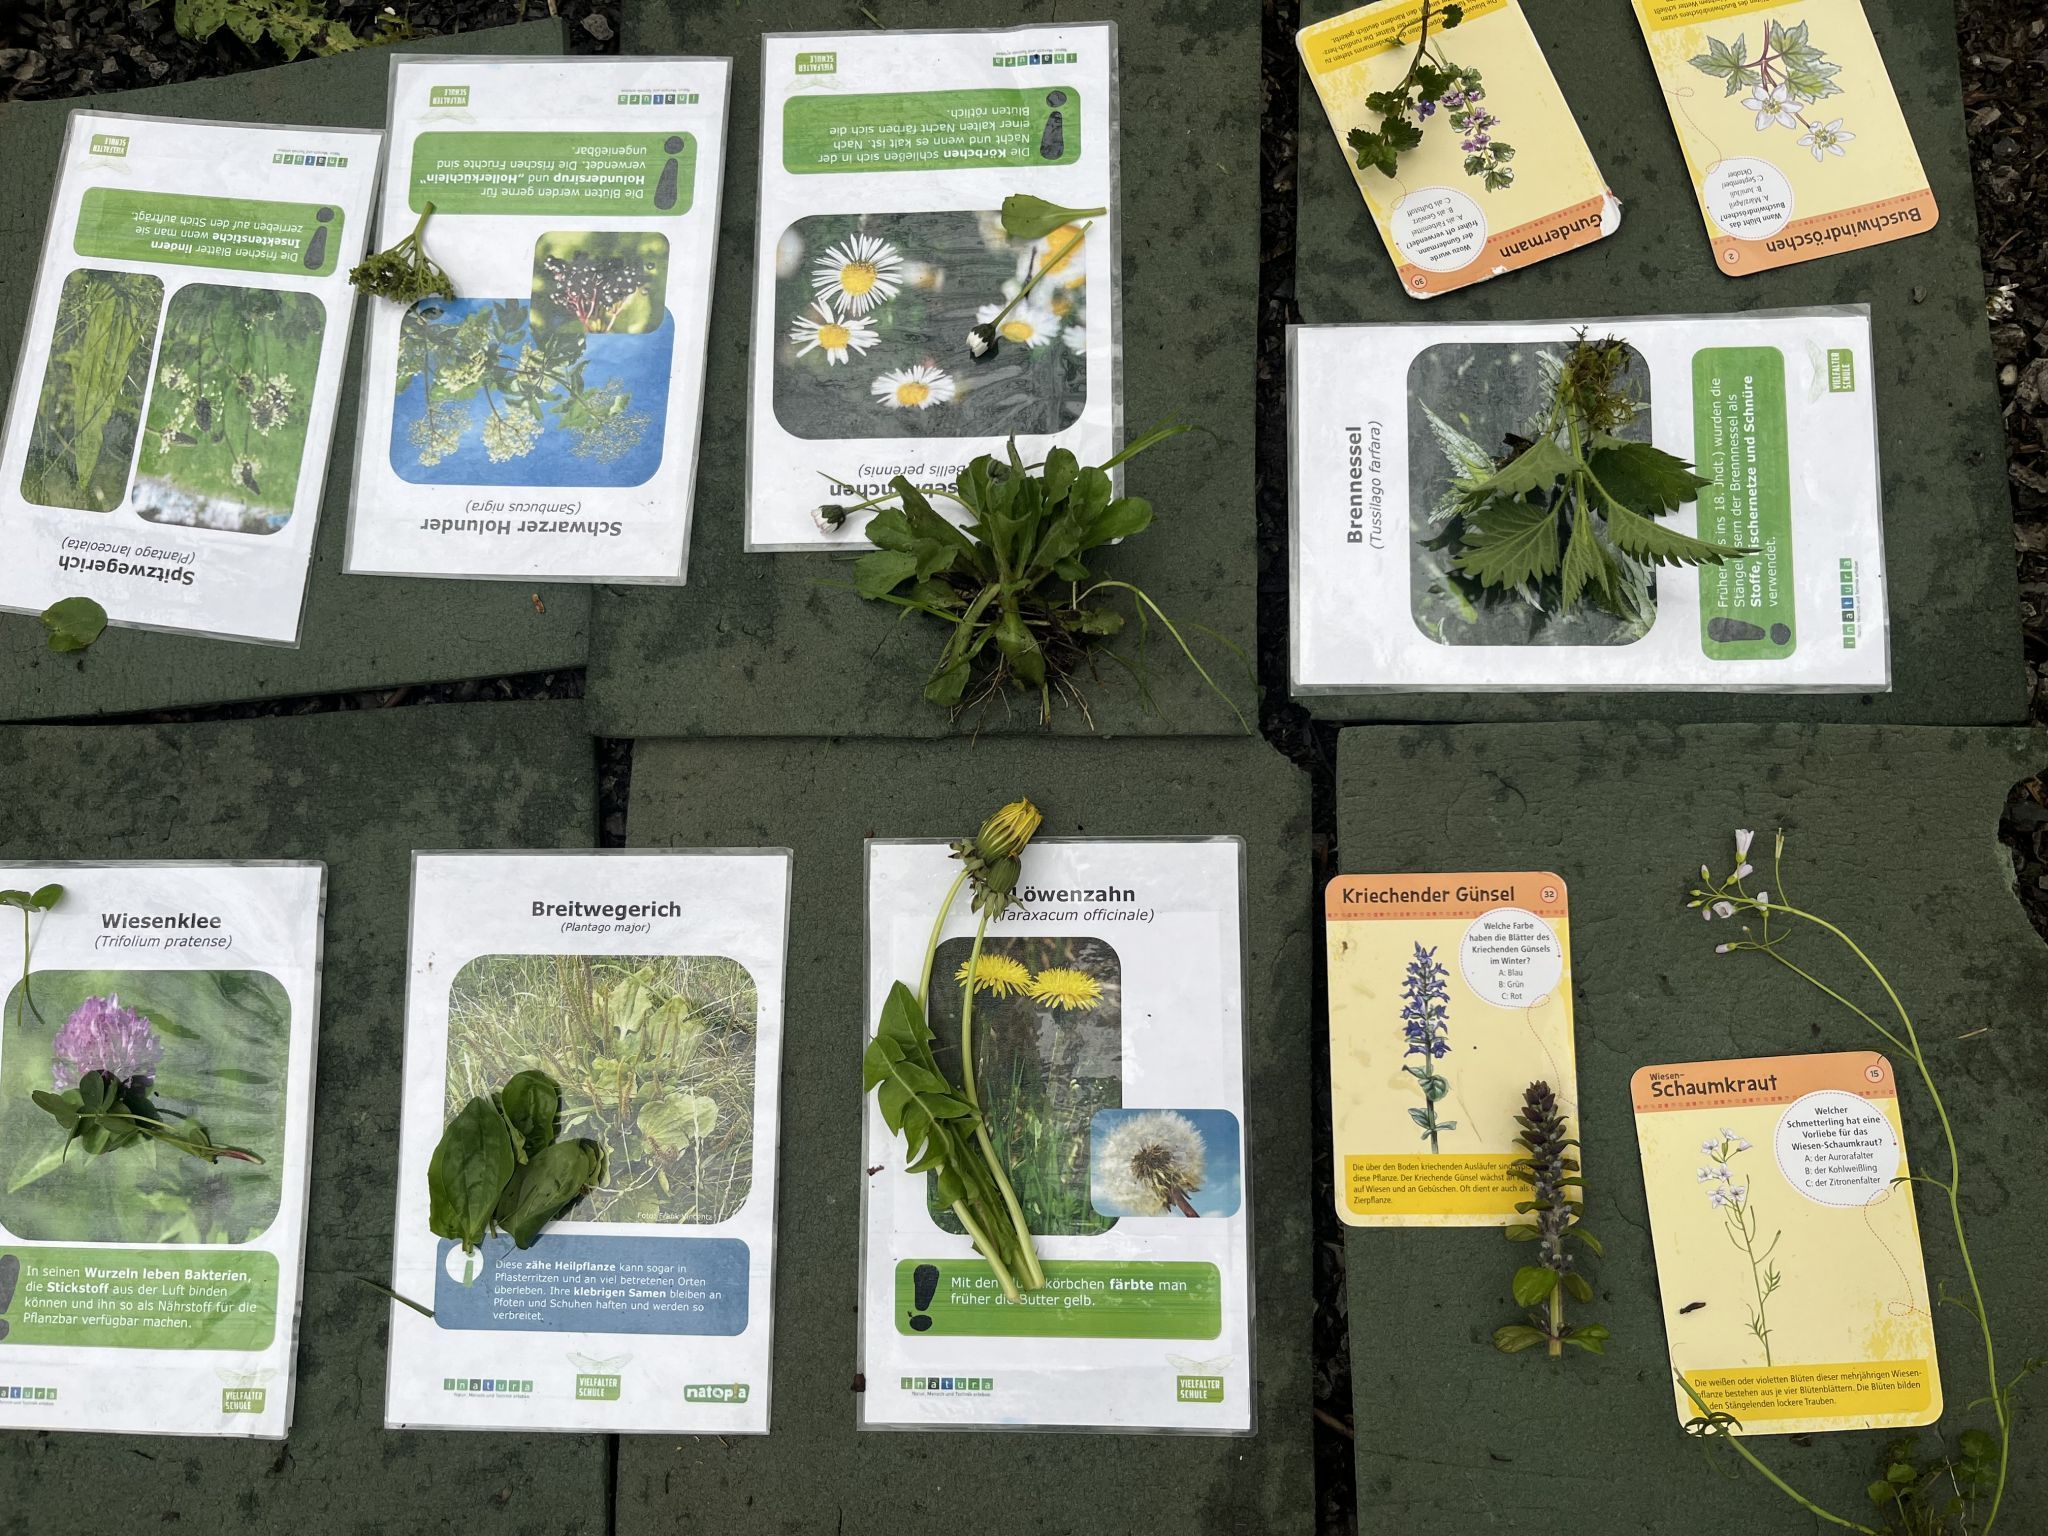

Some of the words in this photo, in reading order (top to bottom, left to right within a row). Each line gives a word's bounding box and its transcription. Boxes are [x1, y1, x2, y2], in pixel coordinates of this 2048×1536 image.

[572, 144, 646, 156] ungenießbar.
[883, 150, 938, 162] schließen
[943, 148, 1006, 159] Körbchen
[1010, 147, 1029, 157] Die
[436, 159, 460, 169] sind
[817, 154, 837, 164] der
[841, 153, 852, 162] in
[856, 152, 879, 163] sich
[463, 159, 506, 170] Früchte
[510, 160, 554, 170] frischen
[558, 160, 577, 170] Die
[582, 160, 645, 171] verwendet.
[528, 174, 549, 184] und
[553, 172, 644, 185] Holundersirup
[480, 187, 497, 198] für
[501, 186, 534, 196] gerne
[537, 187, 580, 198] werden
[584, 188, 620, 198] Blüten
[624, 188, 643, 198] Die
[131, 210, 176, 224] aufträgt.
[179, 216, 206, 227] Stich
[135, 225, 150, 235] sie
[210, 219, 229, 229] den
[231, 220, 250, 230] auf
[253, 222, 303, 233] zerrieben
[1765, 207, 1921, 252] Buschwindröschen
[153, 227, 176, 236] man
[180, 230, 208, 238] wenn
[1499, 213, 1602, 257] Gundermann
[150, 240, 192, 253] lindern
[212, 232, 301, 248] Insektenstiche
[195, 245, 231, 256] Blätter
[235, 248, 277, 261] frischen
[280, 251, 298, 262] Die
[1709, 377, 1721, 396] die
[1726, 394, 1738, 411] als
[1742, 375, 1754, 432] Schnüre
[1710, 400, 1722, 446] wurden
[1367, 420, 1383, 473] farfara)
[1726, 415, 1740, 490] Brennnessel
[1743, 436, 1755, 462] und
[858, 463, 924, 481] perennis)
[928, 464, 966, 476] Bellis
[1345, 426, 1362, 543] Brennessel
[465, 499, 504, 513] nigra)
[1713, 492, 1724, 510] 18.
[1730, 494, 1741, 516] der
[508, 501, 581, 515] (Sambucus
[1368, 477, 1384, 549] (Tussilago
[420, 518, 510, 535] Holunder
[517, 520, 622, 536] Schwarzer
[1714, 516, 1725, 534] ins
[61, 536, 131, 557] lanceolata)
[134, 545, 195, 564] (Plantago
[58, 555, 194, 585] Spitzwegerich
[1764, 536, 1778, 606] verwendet.
[1716, 567, 1728, 607] Früher
[1748, 561, 1761, 607] Stoffe,
[1342, 886, 1450, 903] Kriechender
[1455, 885, 1514, 902] Günsel
[532, 900, 681, 920] Breitwegerich
[1000, 907, 1078, 921] Taraxacum
[1083, 908, 1154, 923] officinale)
[101, 913, 221, 928] Wiesenklee
[1483, 921, 1510, 929] Welche
[1512, 921, 1533, 929] Farbe
[560, 921, 610, 933] (Plantago
[614, 922, 650, 934] major)
[94, 934, 160, 949] (Trifolium
[163, 934, 232, 949] pratense)
[1494, 933, 1506, 941] die
[1508, 933, 1534, 941] Blätter
[1536, 932, 1549, 940] des
[1471, 945, 1518, 953] Kriechenden
[1520, 944, 1550, 952] Günsels
[1500, 956, 1530, 964] Winter?
[1649, 1072, 1684, 1080] Wiesen-
[1651, 1074, 1777, 1097] Schaumkraut
[1814, 1106, 1847, 1115] Welcher
[1786, 1117, 1844, 1128] Schmetterling
[1845, 1116, 1860, 1124] hat
[1862, 1115, 1880, 1123] eine
[1801, 1129, 1836, 1138] Vorliebe
[1838, 1128, 1850, 1136] für
[1853, 1127, 1868, 1135] das
[1791, 1137, 1882, 1150] Wiesen-Schaumkraut?
[1804, 1154, 1812, 1162] A:
[1814, 1153, 1826, 1161] der
[1828, 1151, 1873, 1160] Aurorafalter
[1804, 1166, 1812, 1174] B:
[1814, 1165, 1826, 1174] der
[1828, 1163, 1877, 1173] Kohlweißling
[1805, 1179, 1813, 1187] C:
[1814, 1178, 1827, 1186] der
[1829, 1175, 1880, 1186] Zitronenfalter
[26, 1265, 38, 1275] In
[42, 1266, 79, 1277] seinen
[84, 1266, 138, 1278] Wurzeln
[142, 1267, 179, 1279] leben
[184, 1268, 251, 1282] Bakterien,
[525, 1260, 551, 1269] zähe
[554, 1261, 615, 1272] Heilpflanze
[619, 1262, 643, 1272] kann
[646, 1265, 674, 1274] sogar
[25, 1280, 43, 1291] die
[46, 1281, 109, 1294] Stickstoff
[112, 1285, 133, 1294] aus
[137, 1283, 158, 1294] der
[162, 1284, 184, 1295] Luft
[188, 1285, 227, 1296] binden
[951, 1276, 970, 1288] Mit
[975, 1276, 998, 1288] den
[1109, 1278, 1153, 1290] färbte
[1158, 1281, 1186, 1290] man
[23, 1311, 78, 1324] Pflanzbar
[81, 1313, 139, 1328] verfügbar
[143, 1316, 191, 1328] machen.
